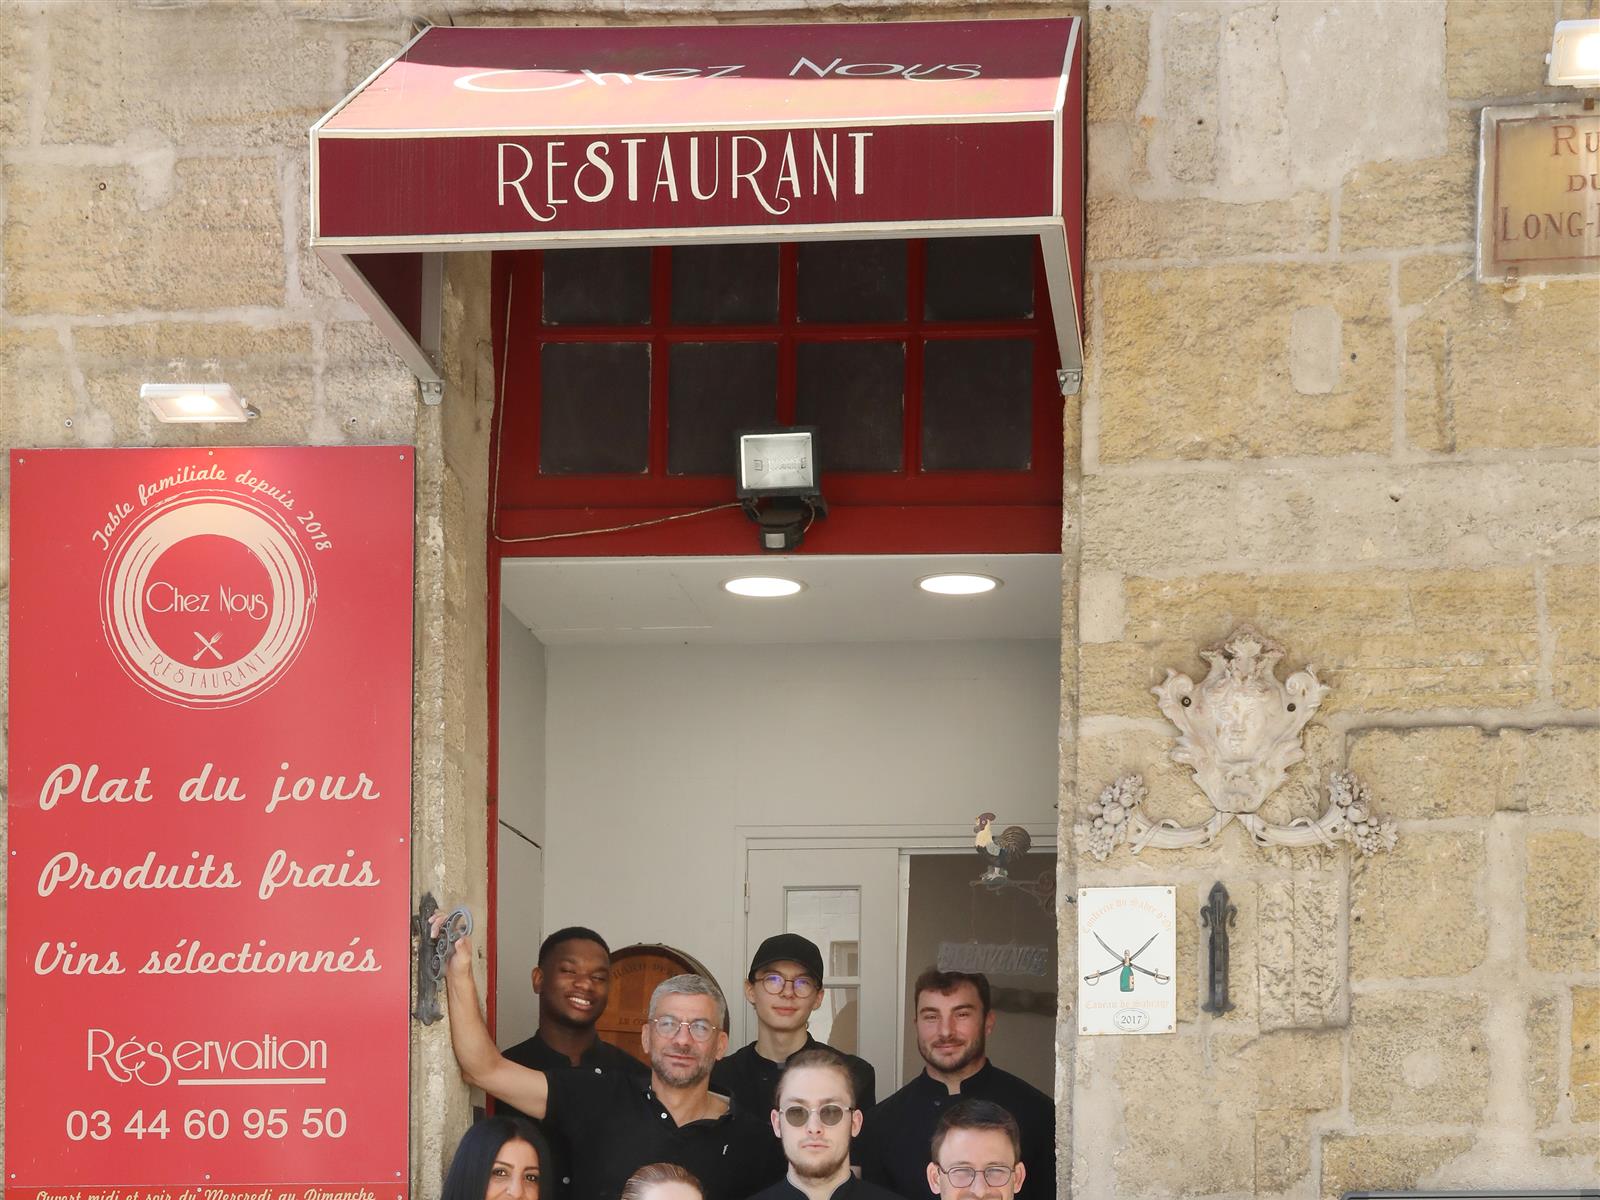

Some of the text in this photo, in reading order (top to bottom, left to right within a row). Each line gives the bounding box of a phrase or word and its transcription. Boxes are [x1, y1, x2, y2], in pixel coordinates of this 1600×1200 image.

[453, 56, 982, 93] Chez Nous
[498, 130, 874, 222] RESTAURANT
[1500, 202, 1600, 241] LONG-
[137, 463, 228, 507] familiale
[234, 469, 295, 511] depuis
[296, 510, 333, 552] 2018
[145, 581, 269, 621] Chez Nous
[149, 652, 267, 689] RESTAURANT
[39, 761, 381, 814] Plat du jour
[37, 849, 381, 901] Produits frais
[34, 936, 382, 976] Vins sélectionnés
[1120, 1015, 1143, 1025] 2017
[87, 1028, 327, 1087] Réservation
[66, 1107, 347, 1141] 03 44 60 95 50
